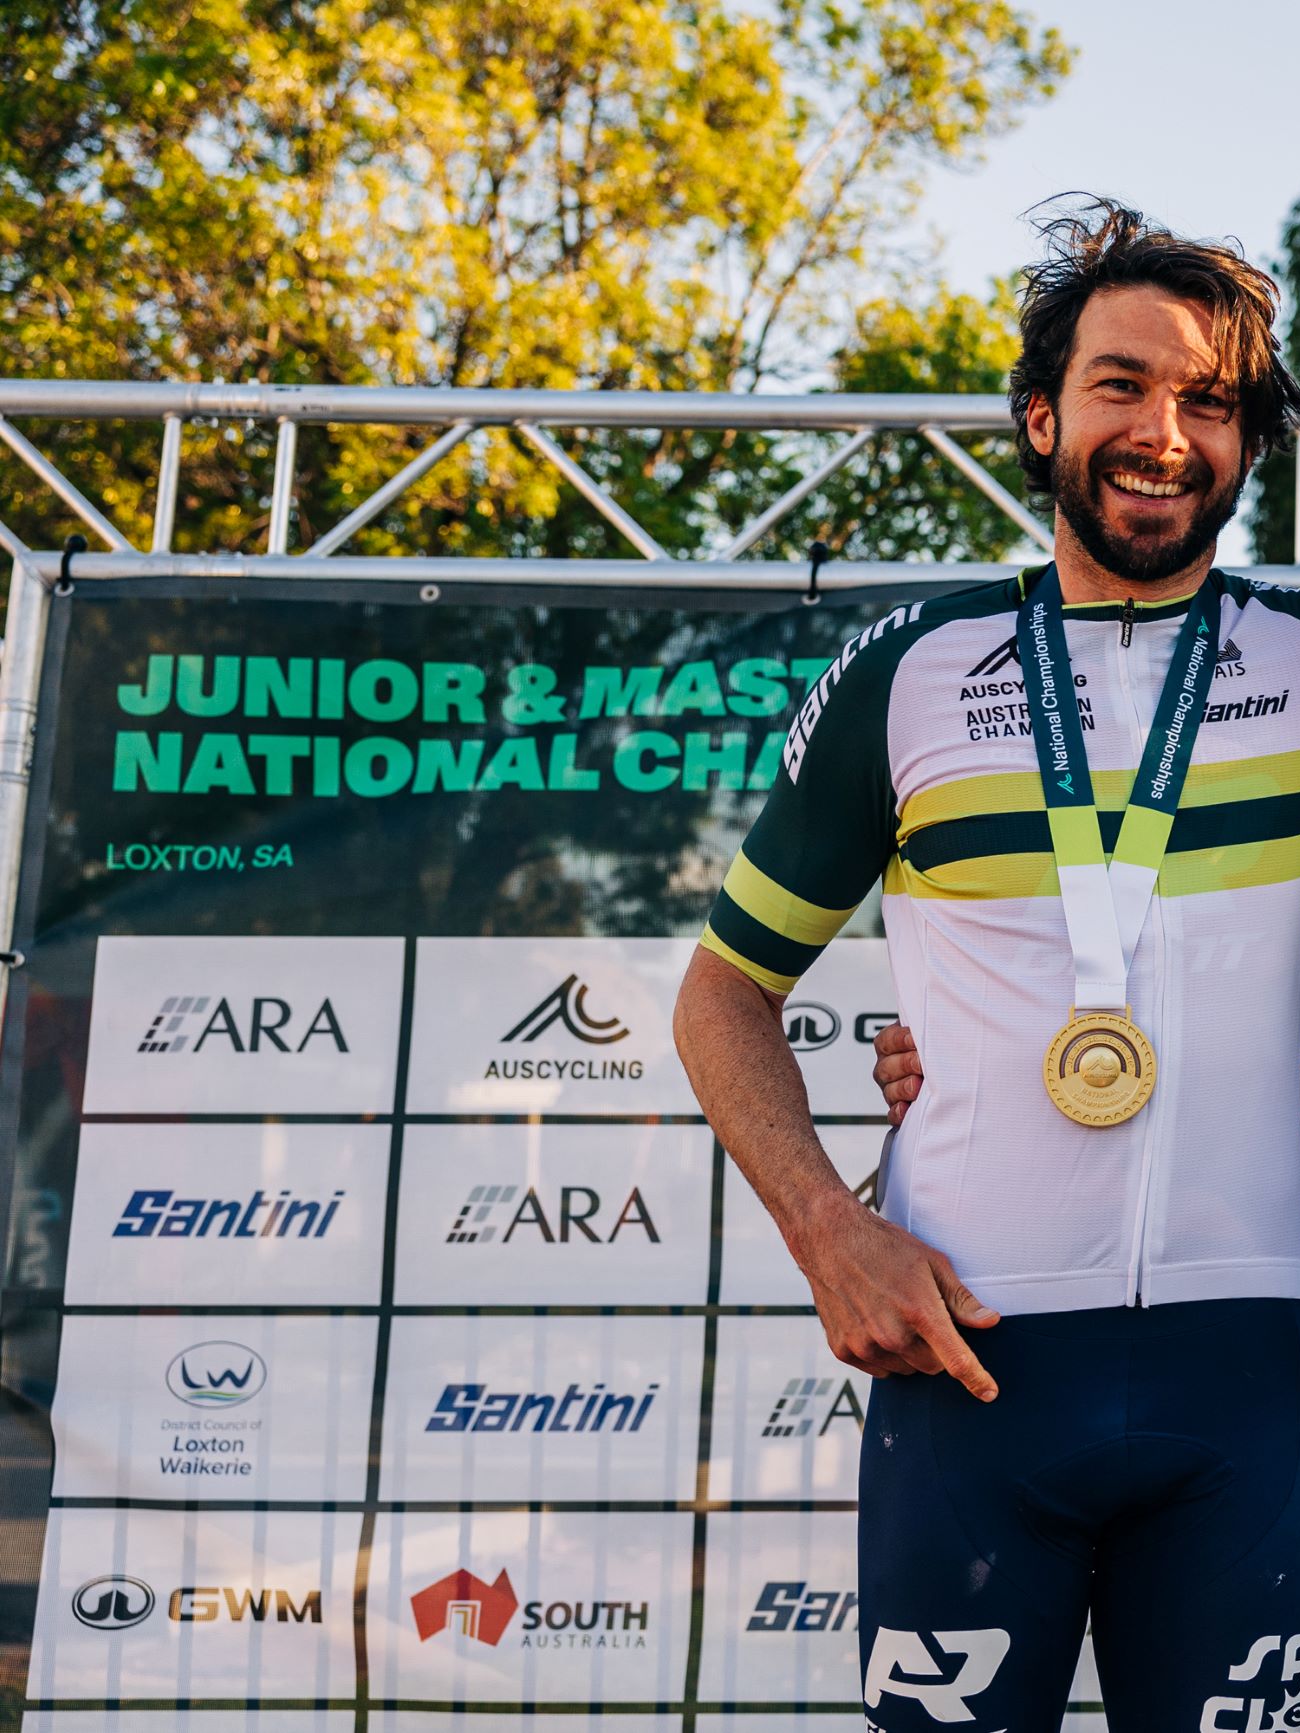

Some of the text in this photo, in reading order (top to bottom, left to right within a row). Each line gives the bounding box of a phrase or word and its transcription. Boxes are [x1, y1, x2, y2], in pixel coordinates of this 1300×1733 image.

[1030, 603, 1070, 771] National Championships
[1215, 662, 1246, 679] AIS
[117, 654, 486, 724] JUNIOR
[501, 663, 567, 725] &
[1201, 690, 1290, 724] antini
[1151, 636, 1209, 800] National Championships
[113, 731, 600, 798] NATIONAL
[106, 843, 294, 872] LOXTON, SA
[194, 998, 349, 1052] ARA
[485, 1059, 643, 1080] AUSCYCLING
[112, 1190, 346, 1238] Santini
[502, 1187, 661, 1243] ARA
[425, 1384, 660, 1433] Santini
[173, 1435, 244, 1453] Loxton
[160, 1456, 252, 1476] Waikerie
[168, 1587, 322, 1624] GWM
[522, 1601, 648, 1631] SOUTH
[521, 1635, 646, 1650] AUSTRALIA
